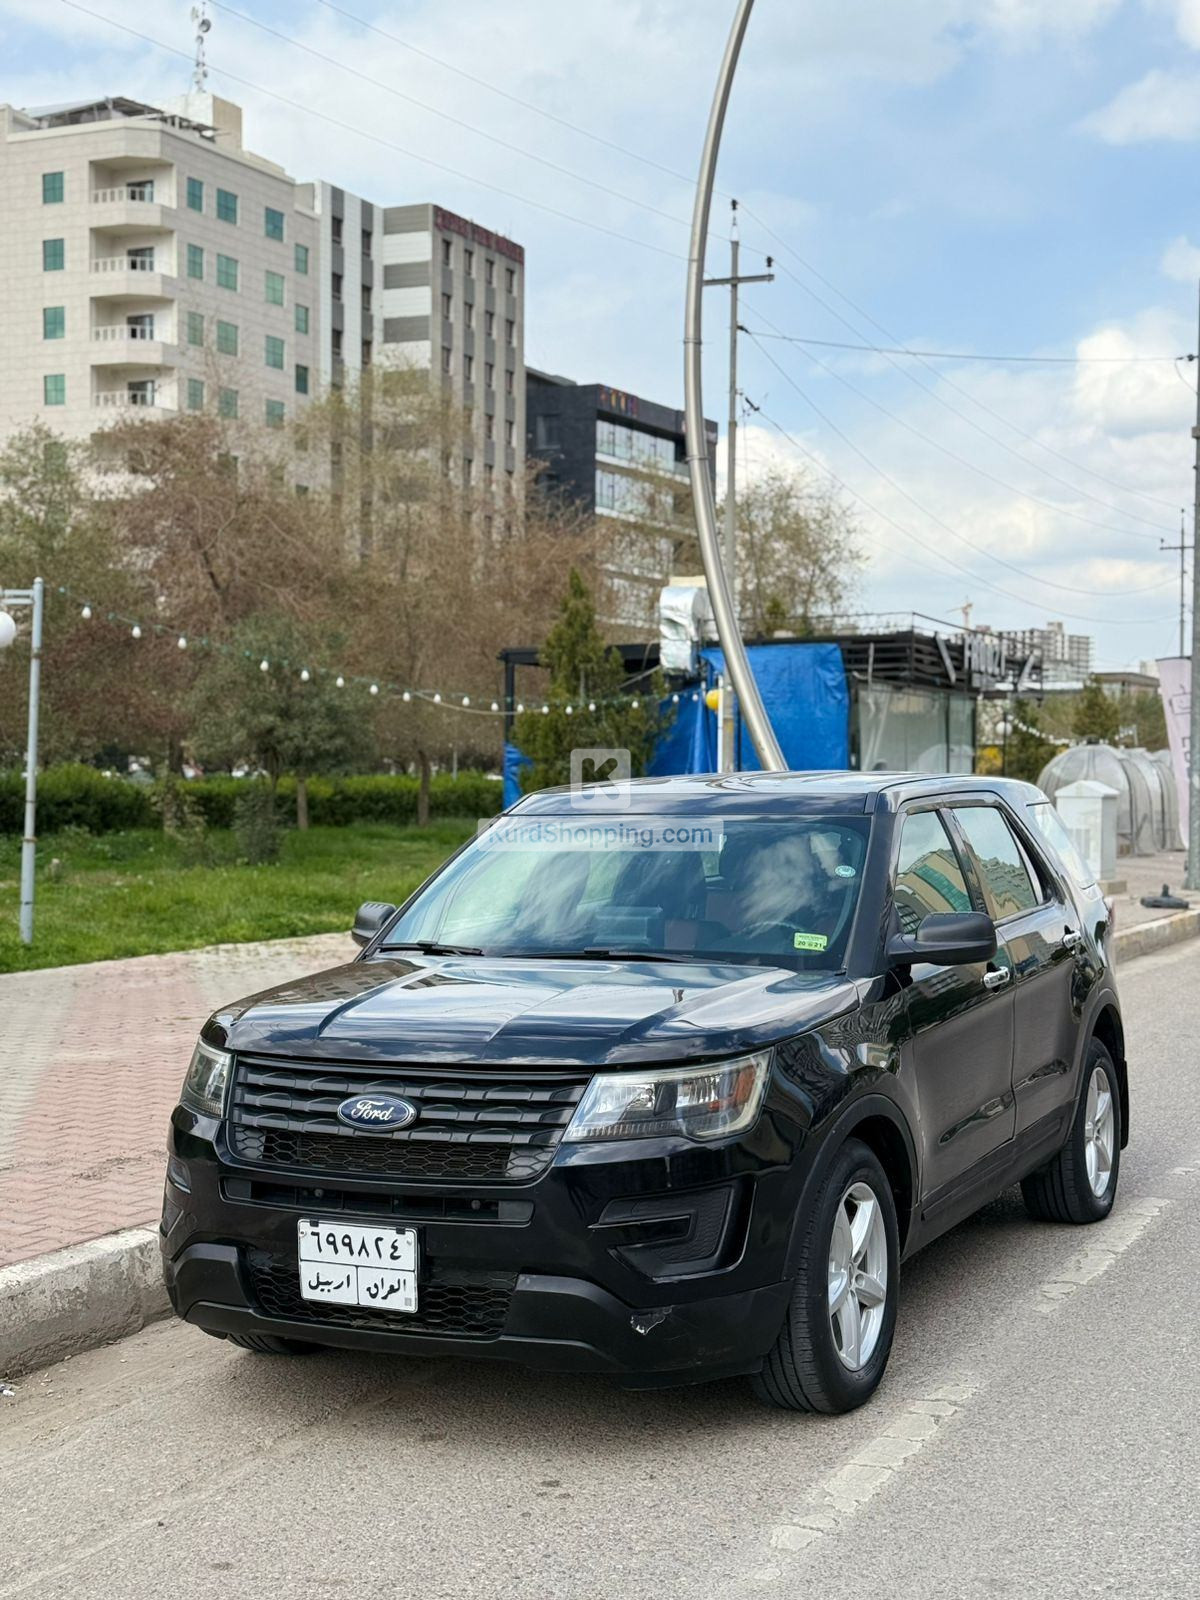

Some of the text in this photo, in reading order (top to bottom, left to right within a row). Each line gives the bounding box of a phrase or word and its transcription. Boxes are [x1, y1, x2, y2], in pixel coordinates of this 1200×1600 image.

[351, 1100, 394, 1120] Ford
[311, 1231, 401, 1260] ٦٩٩٨٢٤
[308, 1272, 350, 1293] اربيل
[366, 1277, 406, 1300] العراق
